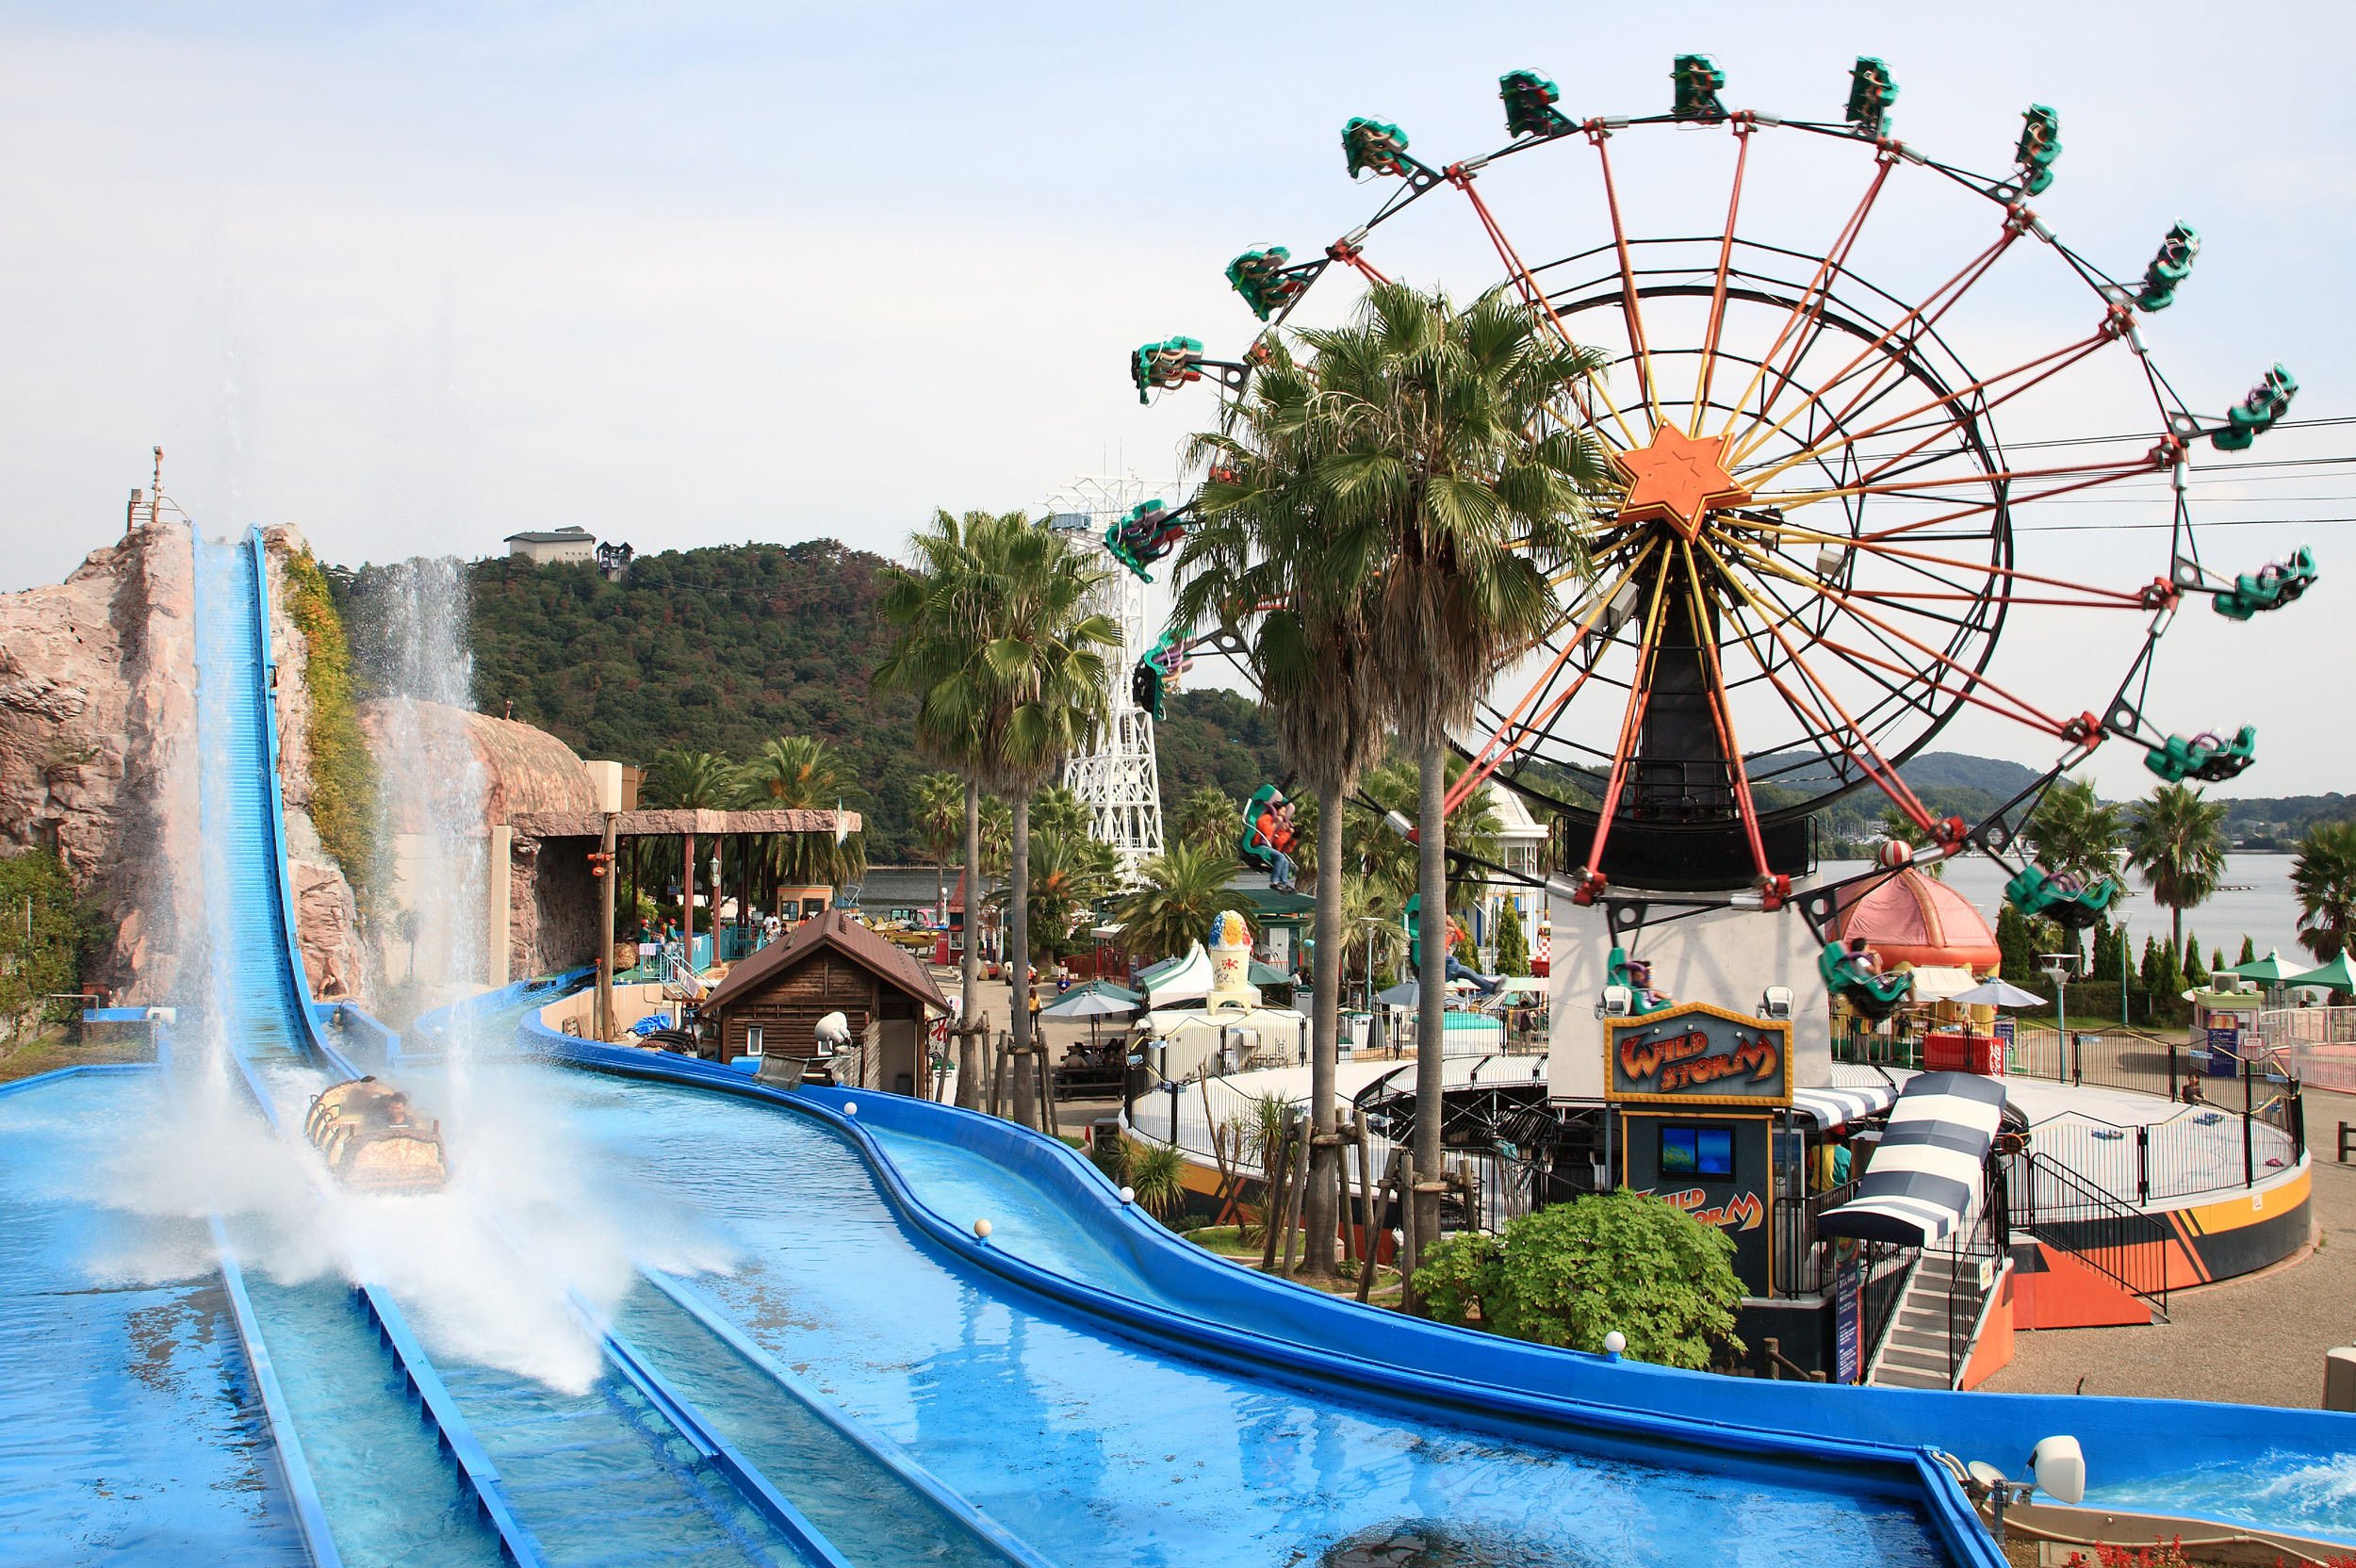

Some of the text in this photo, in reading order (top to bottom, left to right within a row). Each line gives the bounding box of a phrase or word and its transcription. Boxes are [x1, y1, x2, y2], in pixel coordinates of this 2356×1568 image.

[1620, 1031, 1709, 1082] WILD
[1660, 1033, 1777, 1093] STORM
[1635, 1187, 1707, 1211] ILD
[1690, 1191, 1764, 1232] ORM
